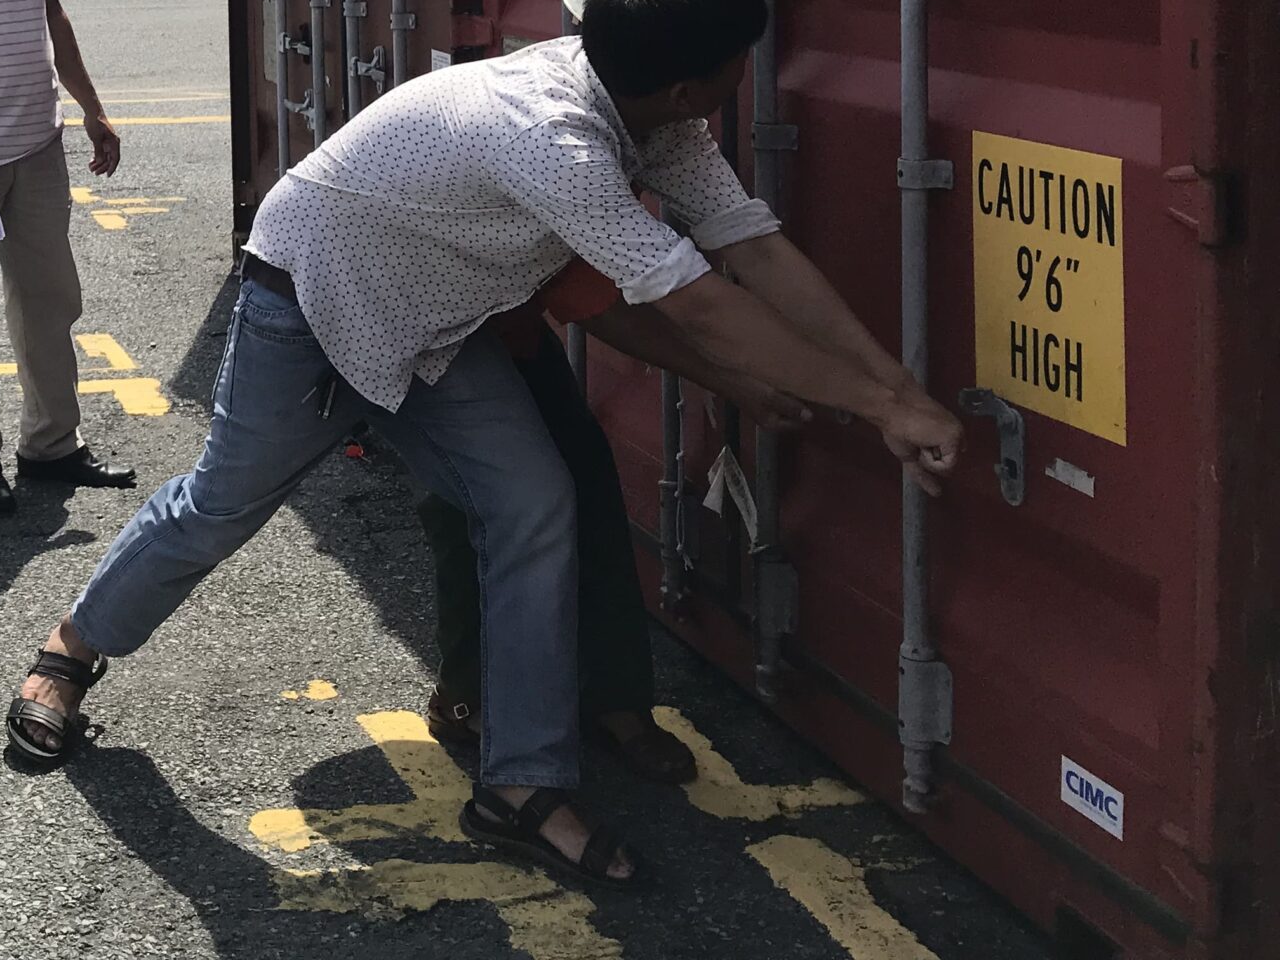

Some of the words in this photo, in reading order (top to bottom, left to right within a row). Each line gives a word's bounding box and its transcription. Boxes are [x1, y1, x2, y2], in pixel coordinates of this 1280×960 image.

[978, 158, 1116, 247] CAUTION
[1010, 320, 1083, 403] HIGH
[1065, 770, 1118, 821] CIMC
